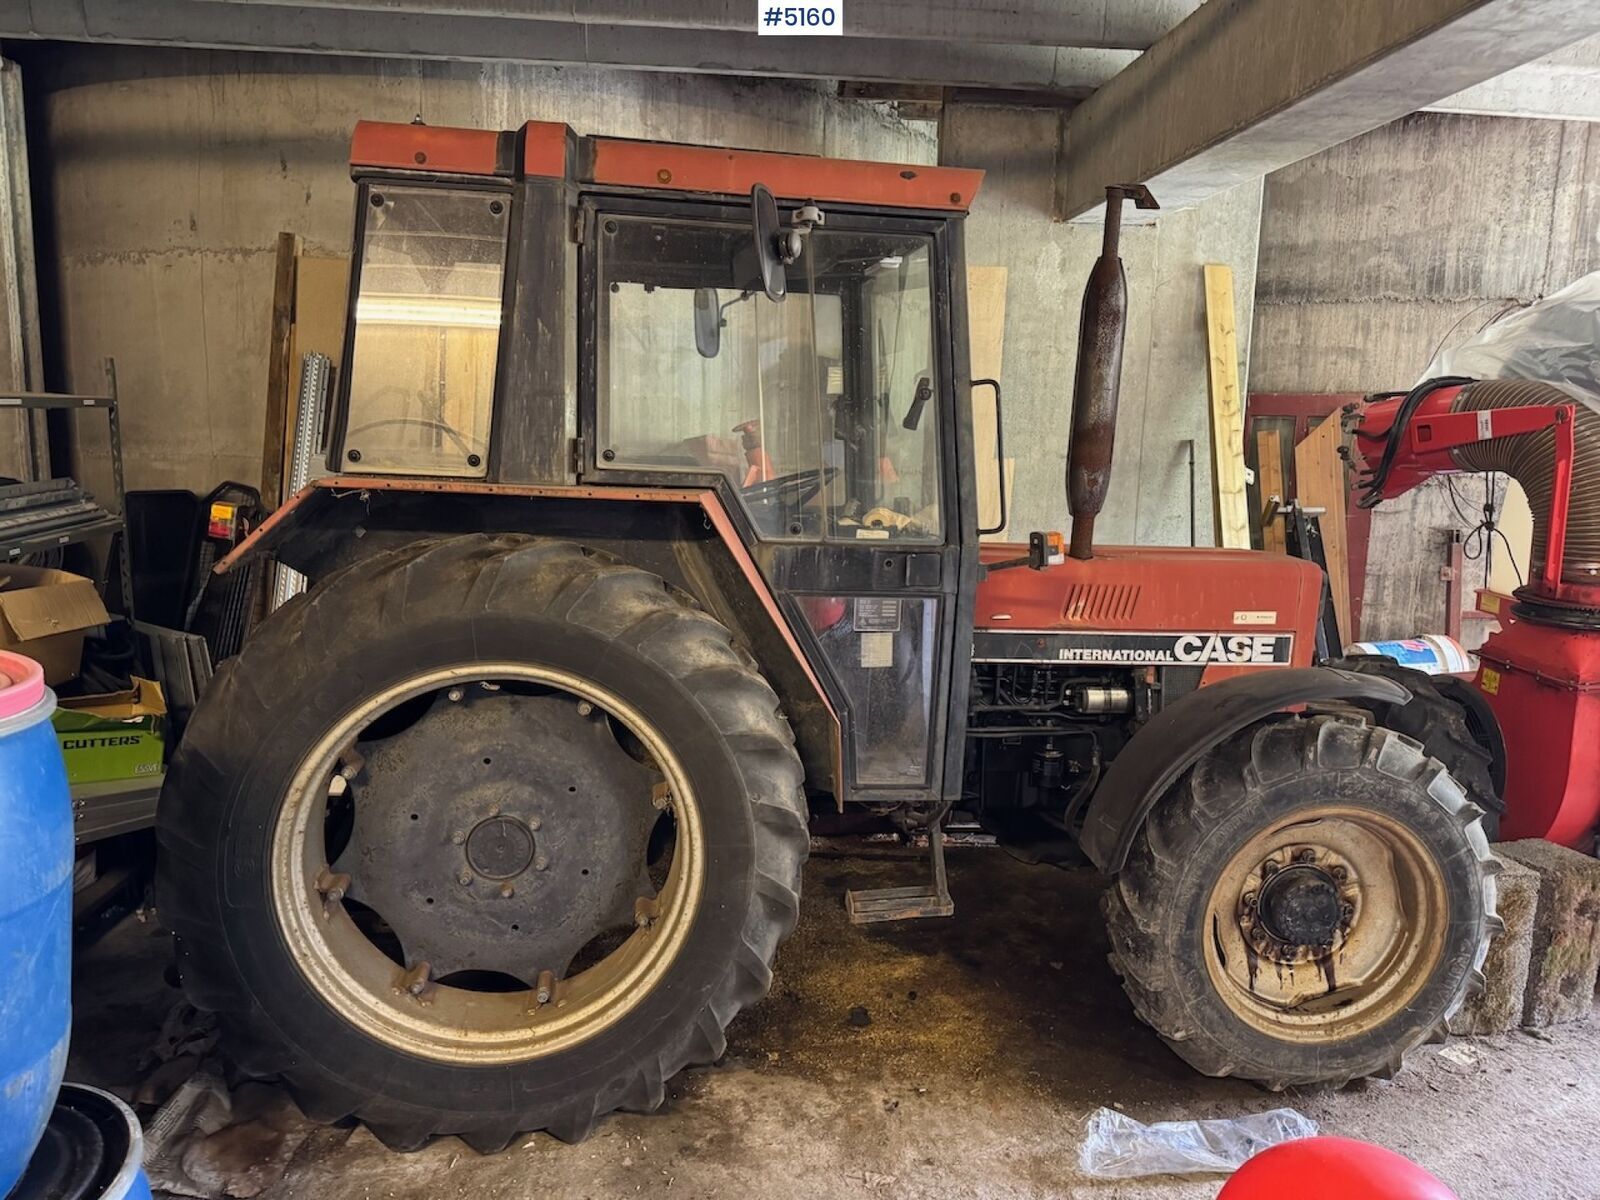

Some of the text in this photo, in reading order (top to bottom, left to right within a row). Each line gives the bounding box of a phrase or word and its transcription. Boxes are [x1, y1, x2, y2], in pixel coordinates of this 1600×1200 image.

[1058, 635, 1276, 662] INTERNATIONAL CASE
[63, 735, 140, 749] CUTTERS
